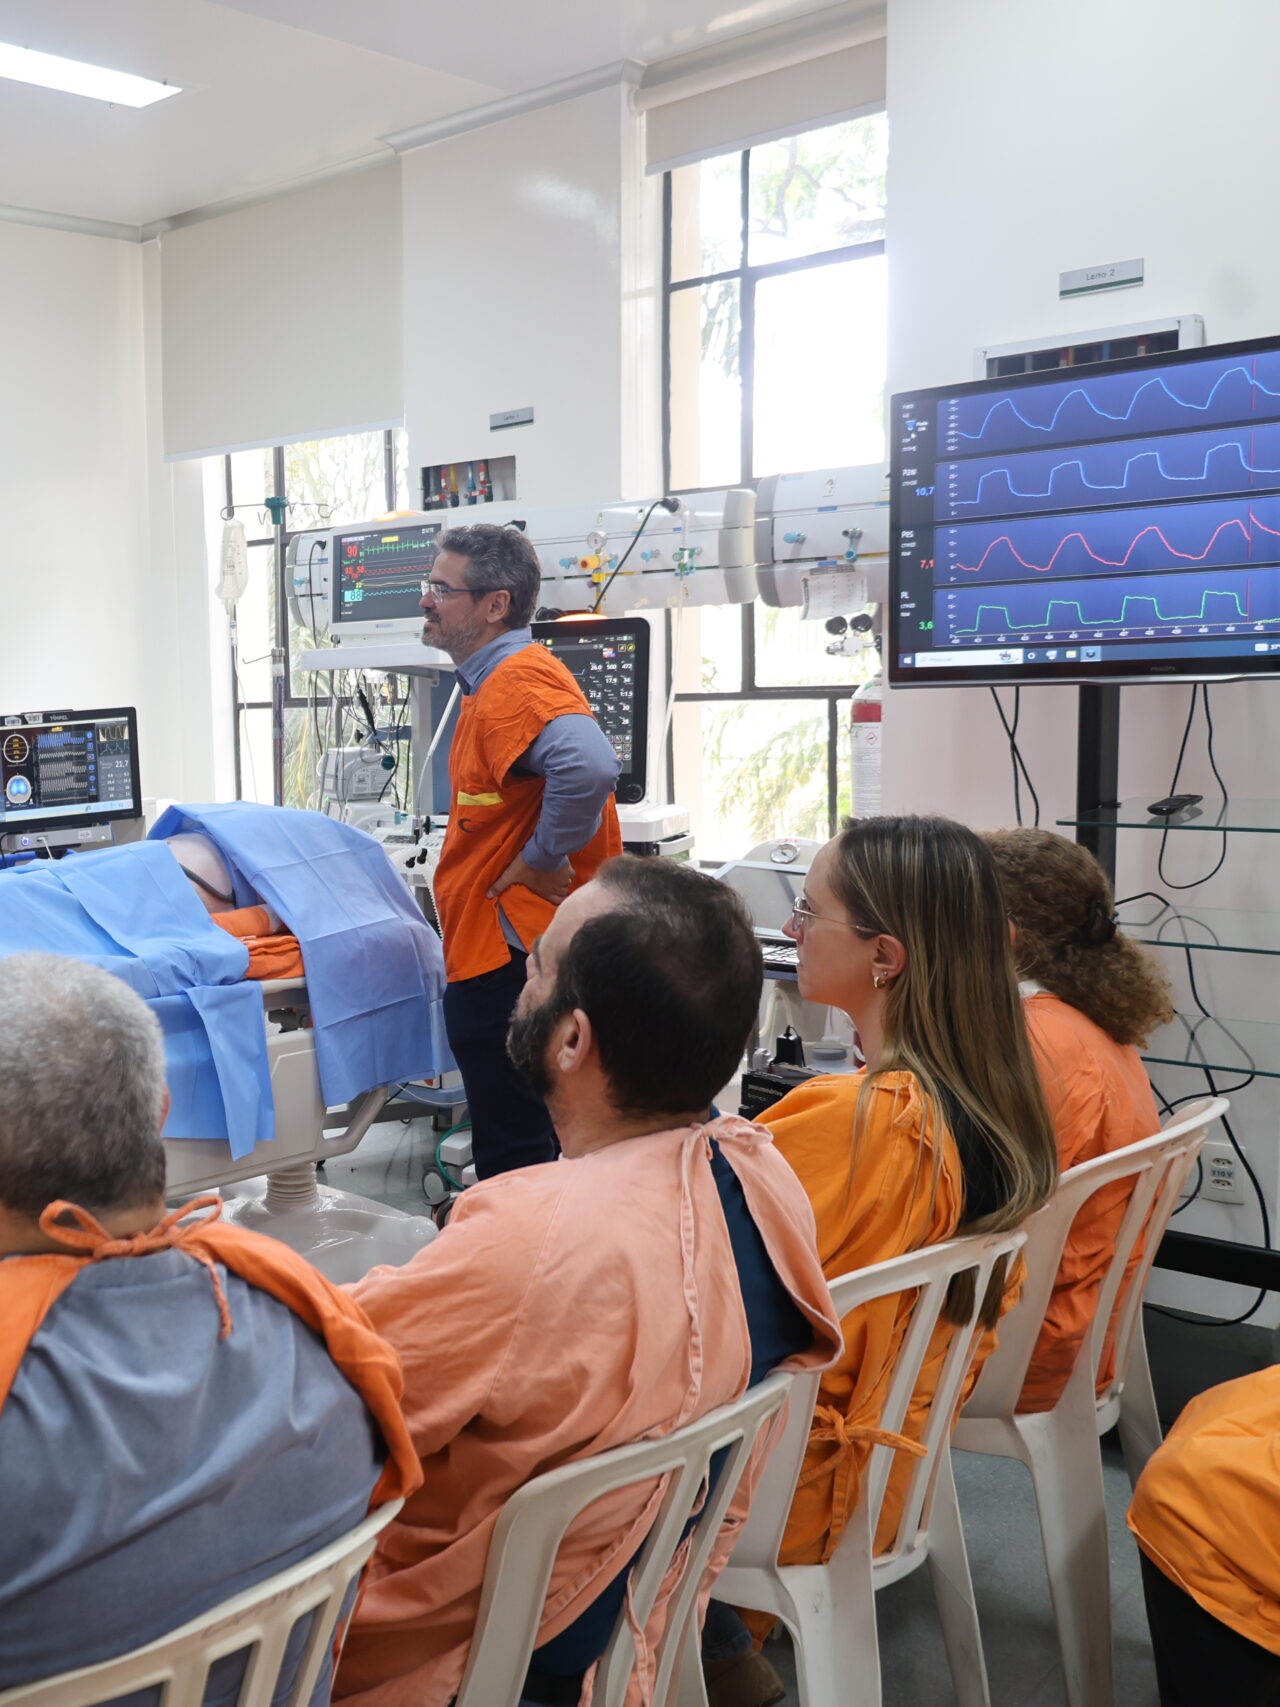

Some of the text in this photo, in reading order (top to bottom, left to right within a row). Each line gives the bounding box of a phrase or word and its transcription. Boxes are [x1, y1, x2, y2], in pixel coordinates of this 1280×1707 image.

[1109, 268, 1115, 276] 2
[915, 486, 934, 496] 10,7
[347, 545, 358, 558] 90
[920, 560, 934, 568] 7,1
[919, 622, 934, 630] 3,6
